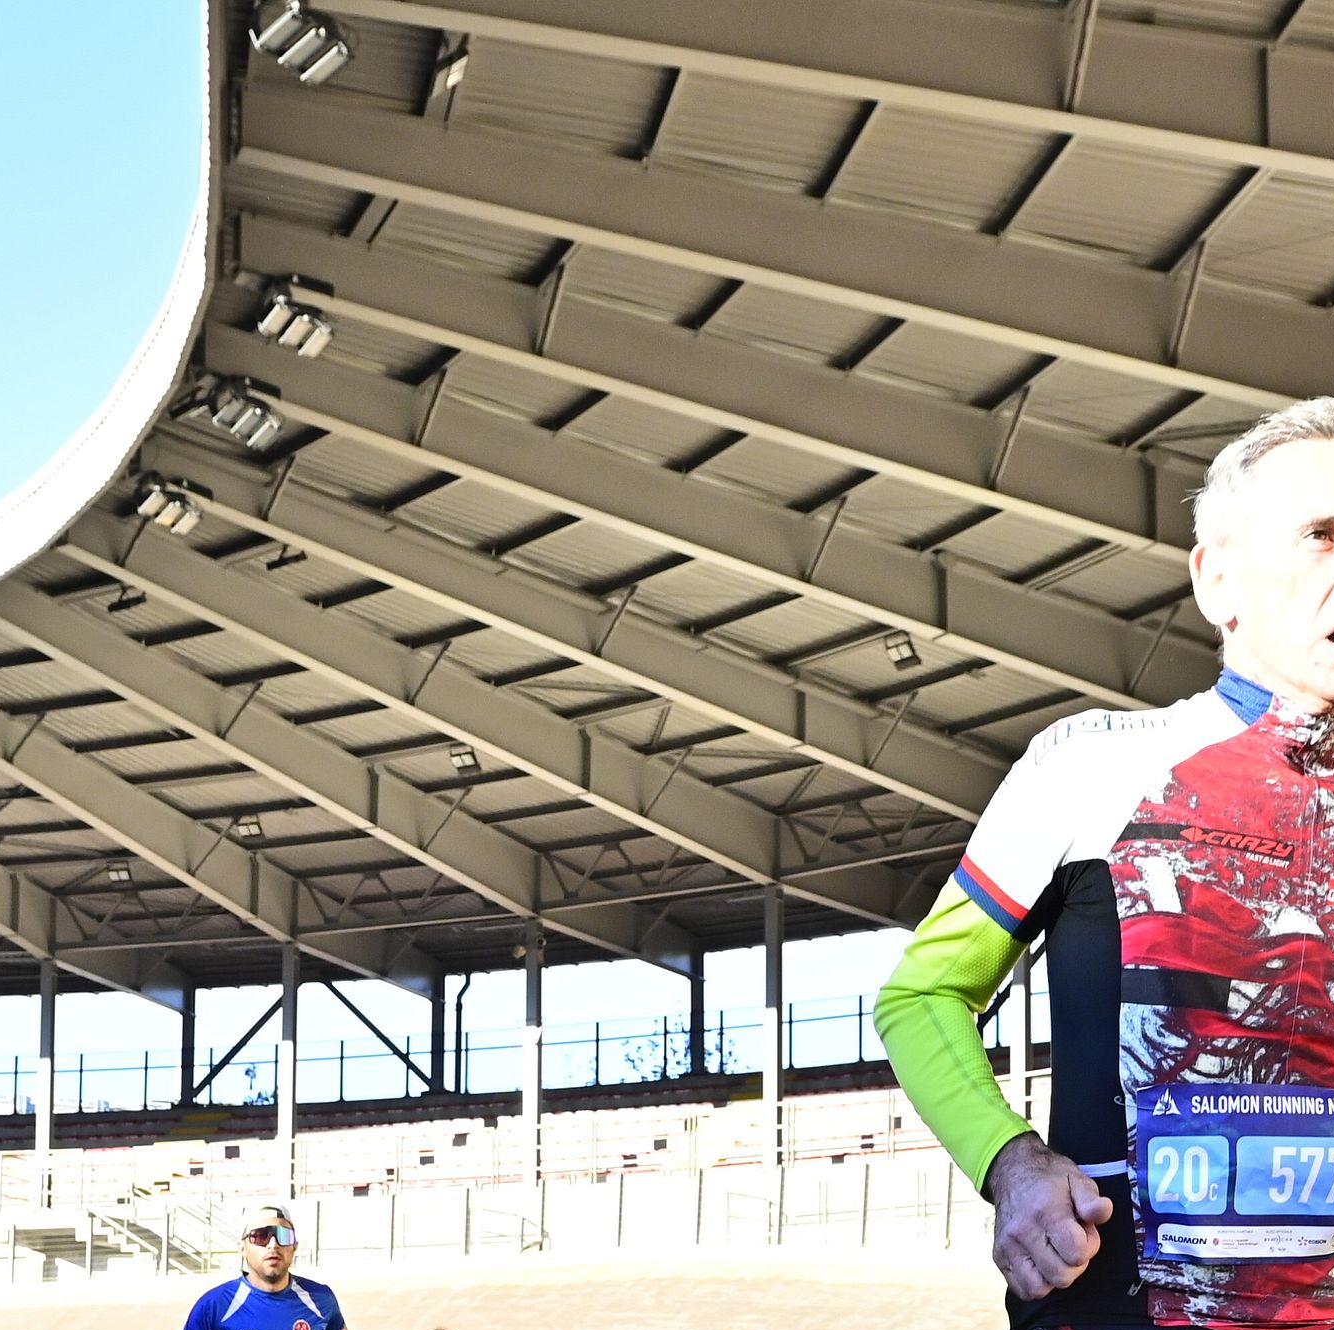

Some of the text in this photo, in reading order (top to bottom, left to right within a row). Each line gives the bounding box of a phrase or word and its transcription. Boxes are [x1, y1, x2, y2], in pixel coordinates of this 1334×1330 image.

[1206, 831, 1294, 858] CRAZY
[1191, 1095, 1260, 1114] SALOMON
[1263, 1096, 1325, 1115] RUNNING
[1161, 1234, 1208, 1246] SALOMON
